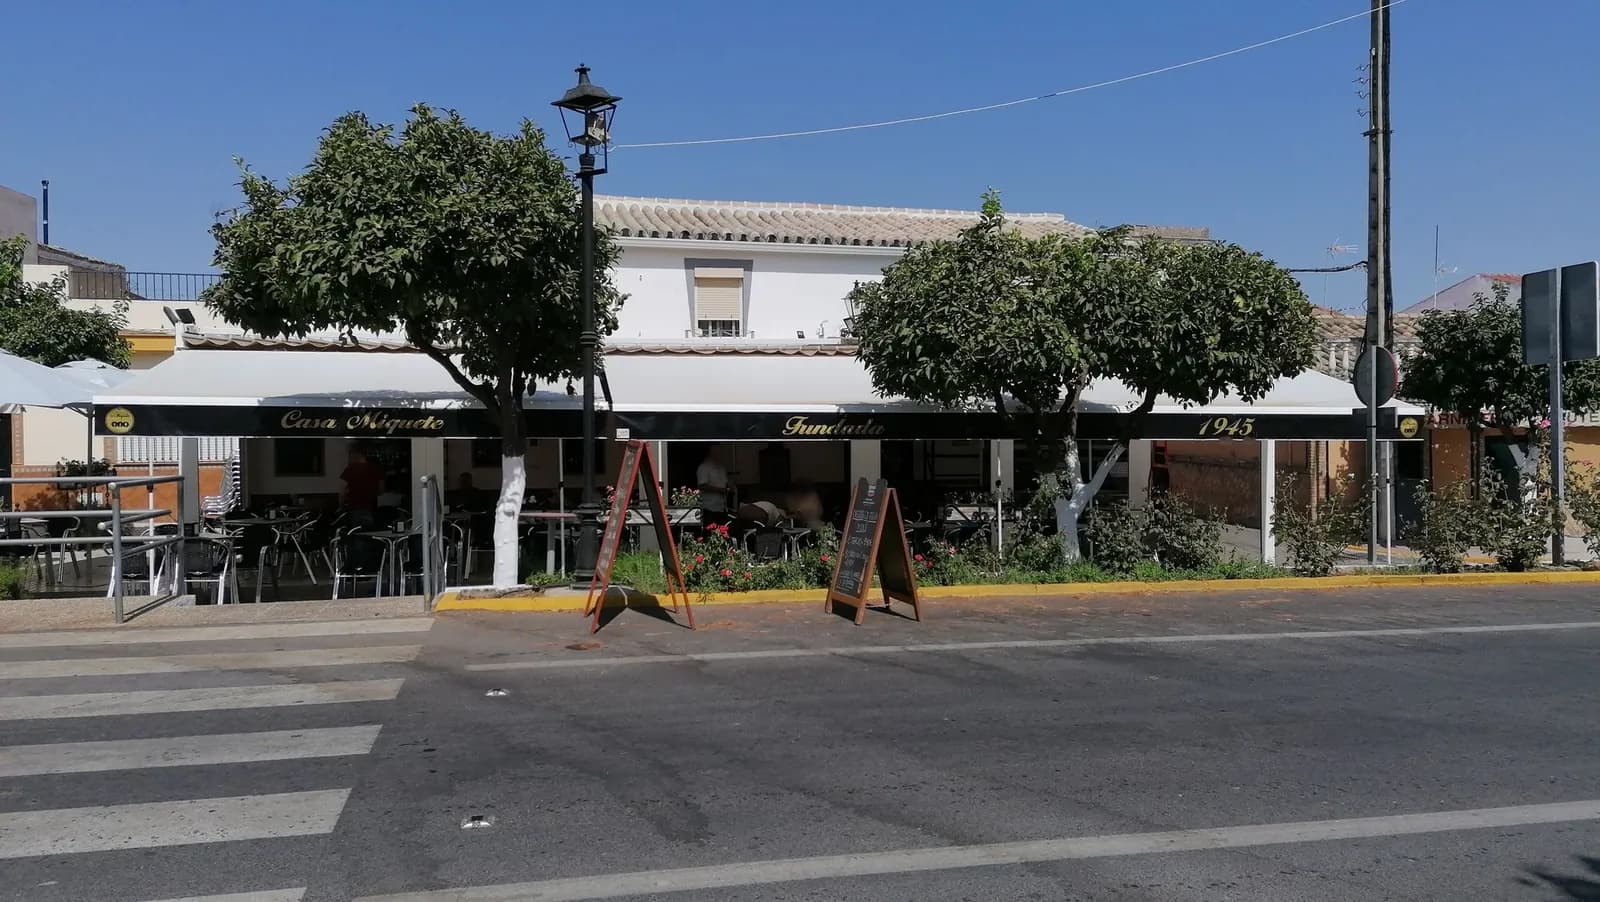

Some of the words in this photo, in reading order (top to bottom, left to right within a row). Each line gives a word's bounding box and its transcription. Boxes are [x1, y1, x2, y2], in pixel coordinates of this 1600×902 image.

[280, 409, 337, 430] Casa
[346, 410, 445, 435] Miquete
[781, 415, 886, 436] Fundada
[1199, 417, 1256, 436] 1945
